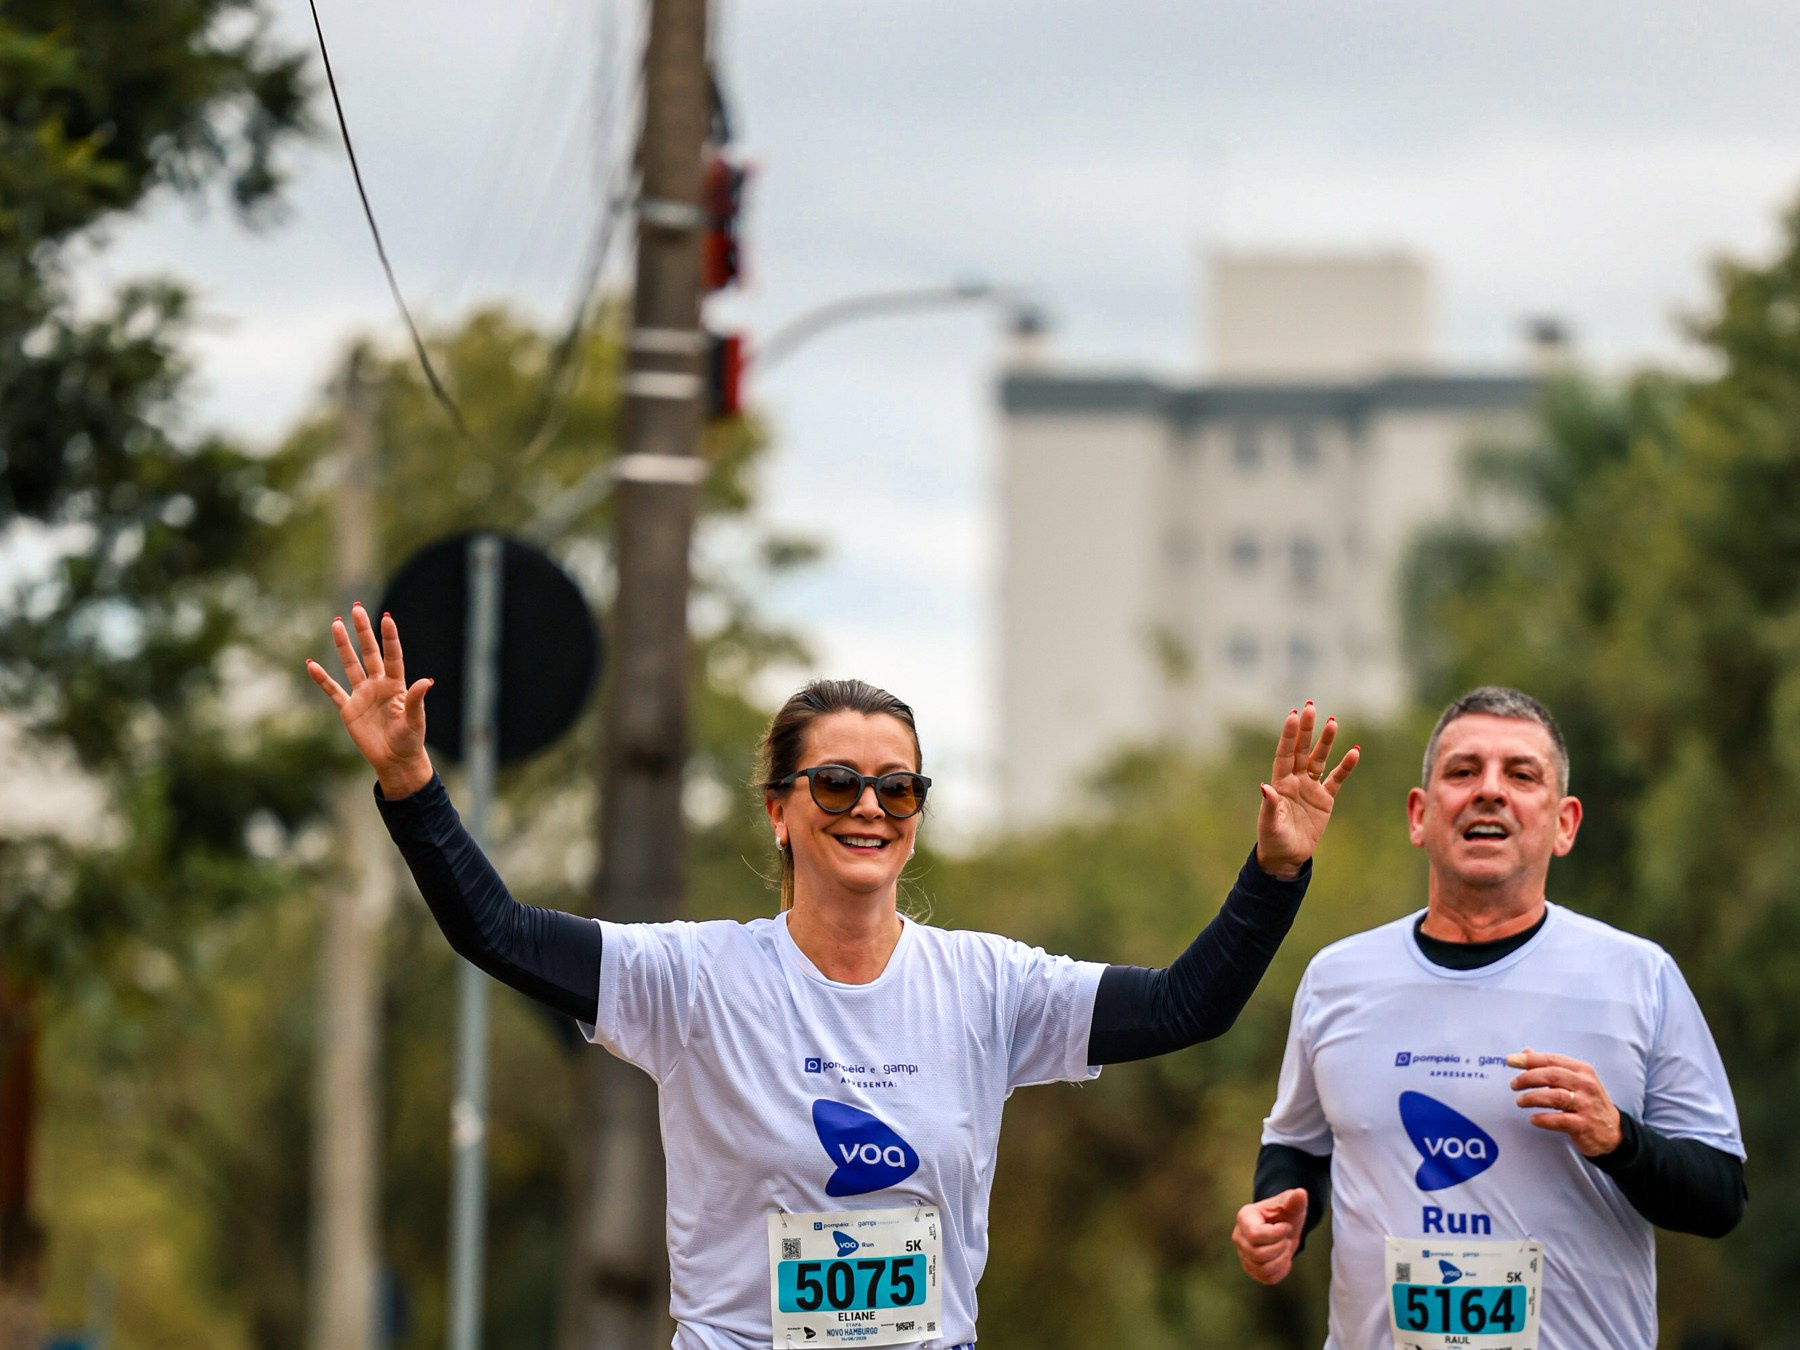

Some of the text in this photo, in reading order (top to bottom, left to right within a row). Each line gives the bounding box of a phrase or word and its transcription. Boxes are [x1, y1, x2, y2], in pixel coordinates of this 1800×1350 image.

[870, 1066, 876, 1074] e
[883, 1063, 918, 1076] gampi
[1423, 1137, 1487, 1159] voa
[838, 1143, 906, 1168] voa
[1422, 1206, 1492, 1235] Run
[839, 1241, 857, 1249] voa
[905, 1239, 922, 1252] 5K
[1506, 1272, 1522, 1283] 5K
[795, 1258, 915, 1311] 5075
[838, 1311, 876, 1322] ELIANE
[1408, 1287, 1515, 1333] 5164
[826, 1326, 878, 1337] NOVO HAMBURGO
[1444, 1335, 1471, 1345] RAUL
